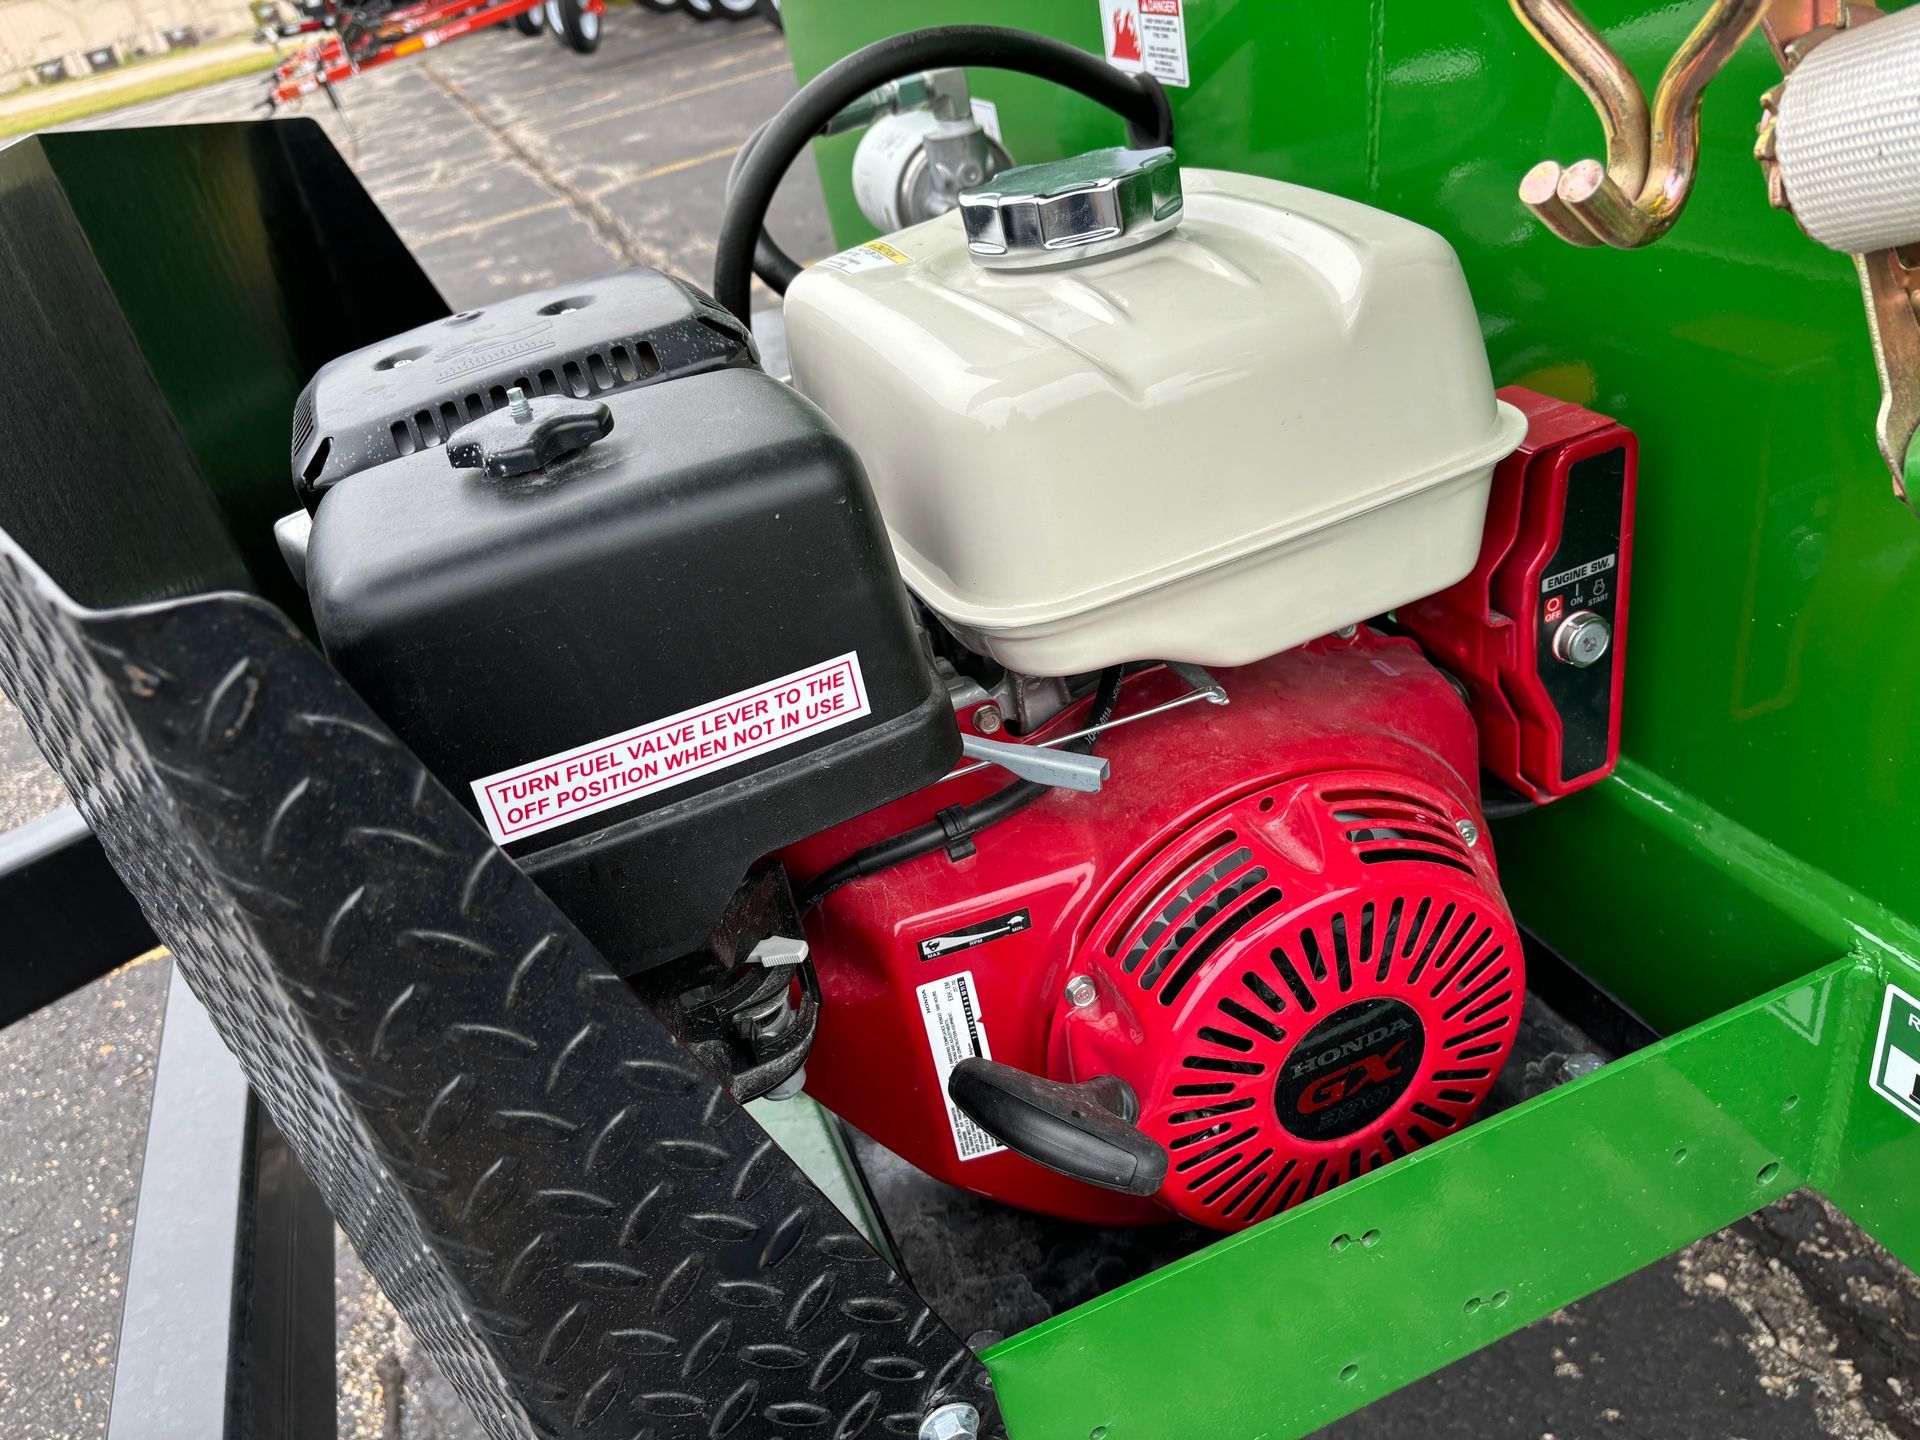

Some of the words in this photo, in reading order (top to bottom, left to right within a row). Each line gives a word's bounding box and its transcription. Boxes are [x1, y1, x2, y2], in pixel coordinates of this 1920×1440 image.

[1147, 0, 1176, 13] DANGER
[1547, 566, 1587, 590] ENGINE
[1591, 558, 1611, 573] SW.
[1570, 596, 1583, 606] ON
[1588, 593, 1608, 606] START
[1545, 612, 1561, 623] OFF
[498, 772, 559, 803] TURN
[566, 752, 623, 782] FUEL
[627, 725, 695, 760] VALVE
[702, 700, 768, 736] LEVER
[774, 689, 800, 708] TO
[806, 671, 845, 697] THE
[508, 797, 550, 824] OFF
[557, 760, 658, 809] POSITION
[664, 736, 727, 770] WHEN
[734, 718, 775, 747] NOT
[781, 710, 799, 730] IN
[806, 693, 845, 719] USE
[921, 989, 931, 1013] HONDA
[1291, 1018, 1412, 1079] HONDA
[1297, 1040, 1408, 1114] GX
